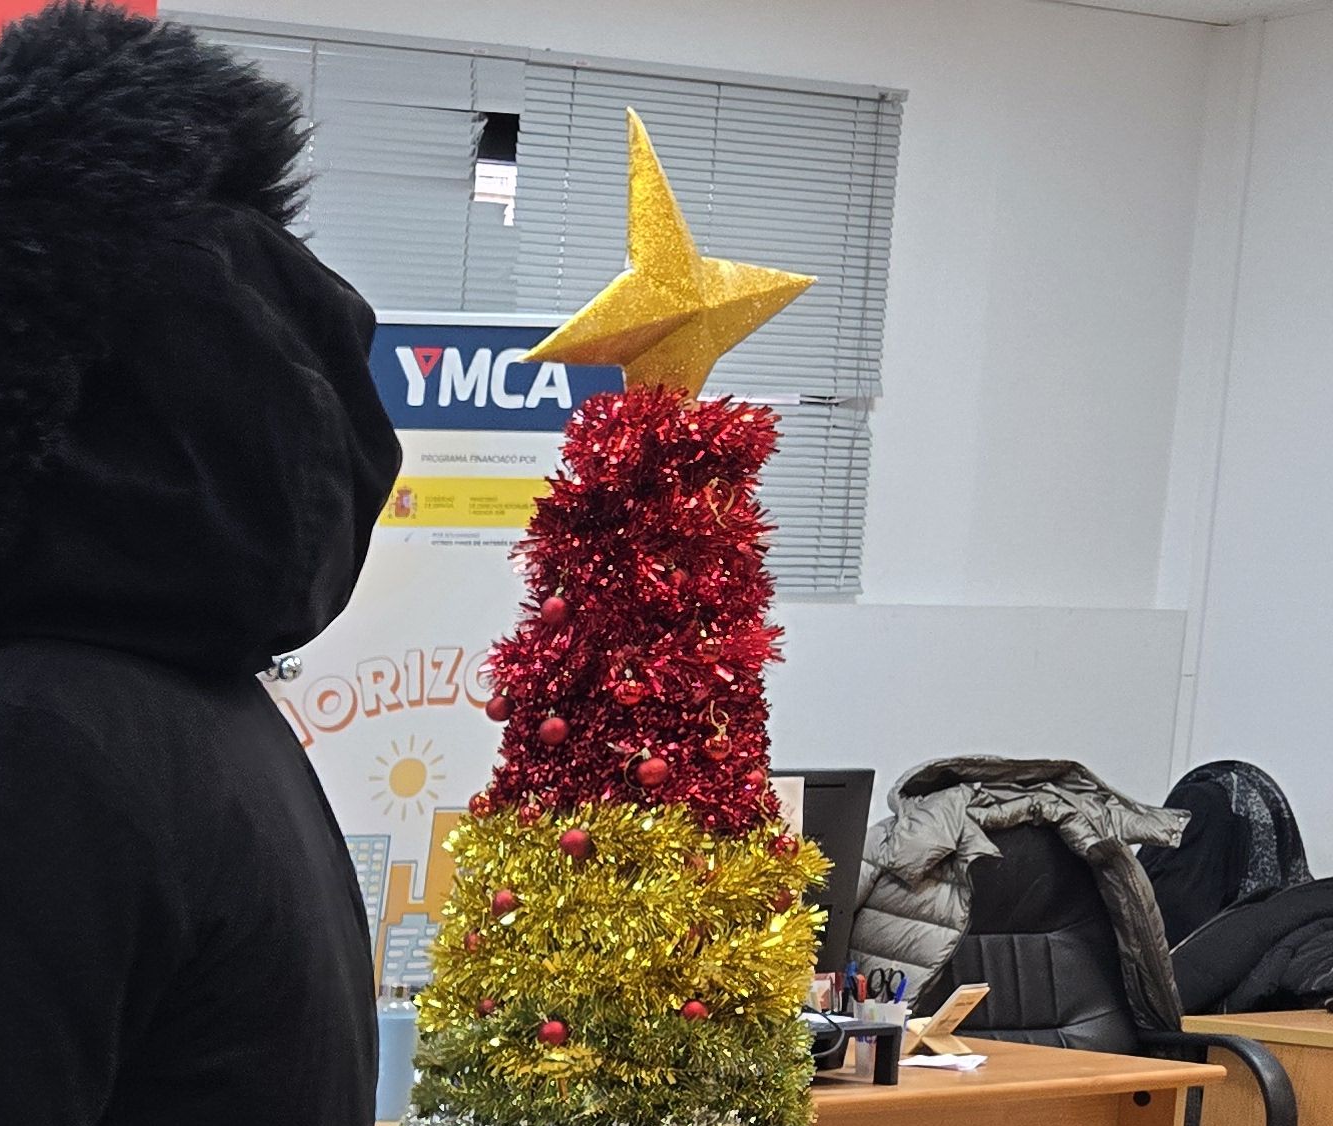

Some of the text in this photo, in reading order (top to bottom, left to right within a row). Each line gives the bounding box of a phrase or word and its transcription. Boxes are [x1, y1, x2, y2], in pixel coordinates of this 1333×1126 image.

[395, 345, 573, 409] YMCA
[421, 454, 537, 465] PROGRAMA FINANCIADO POR
